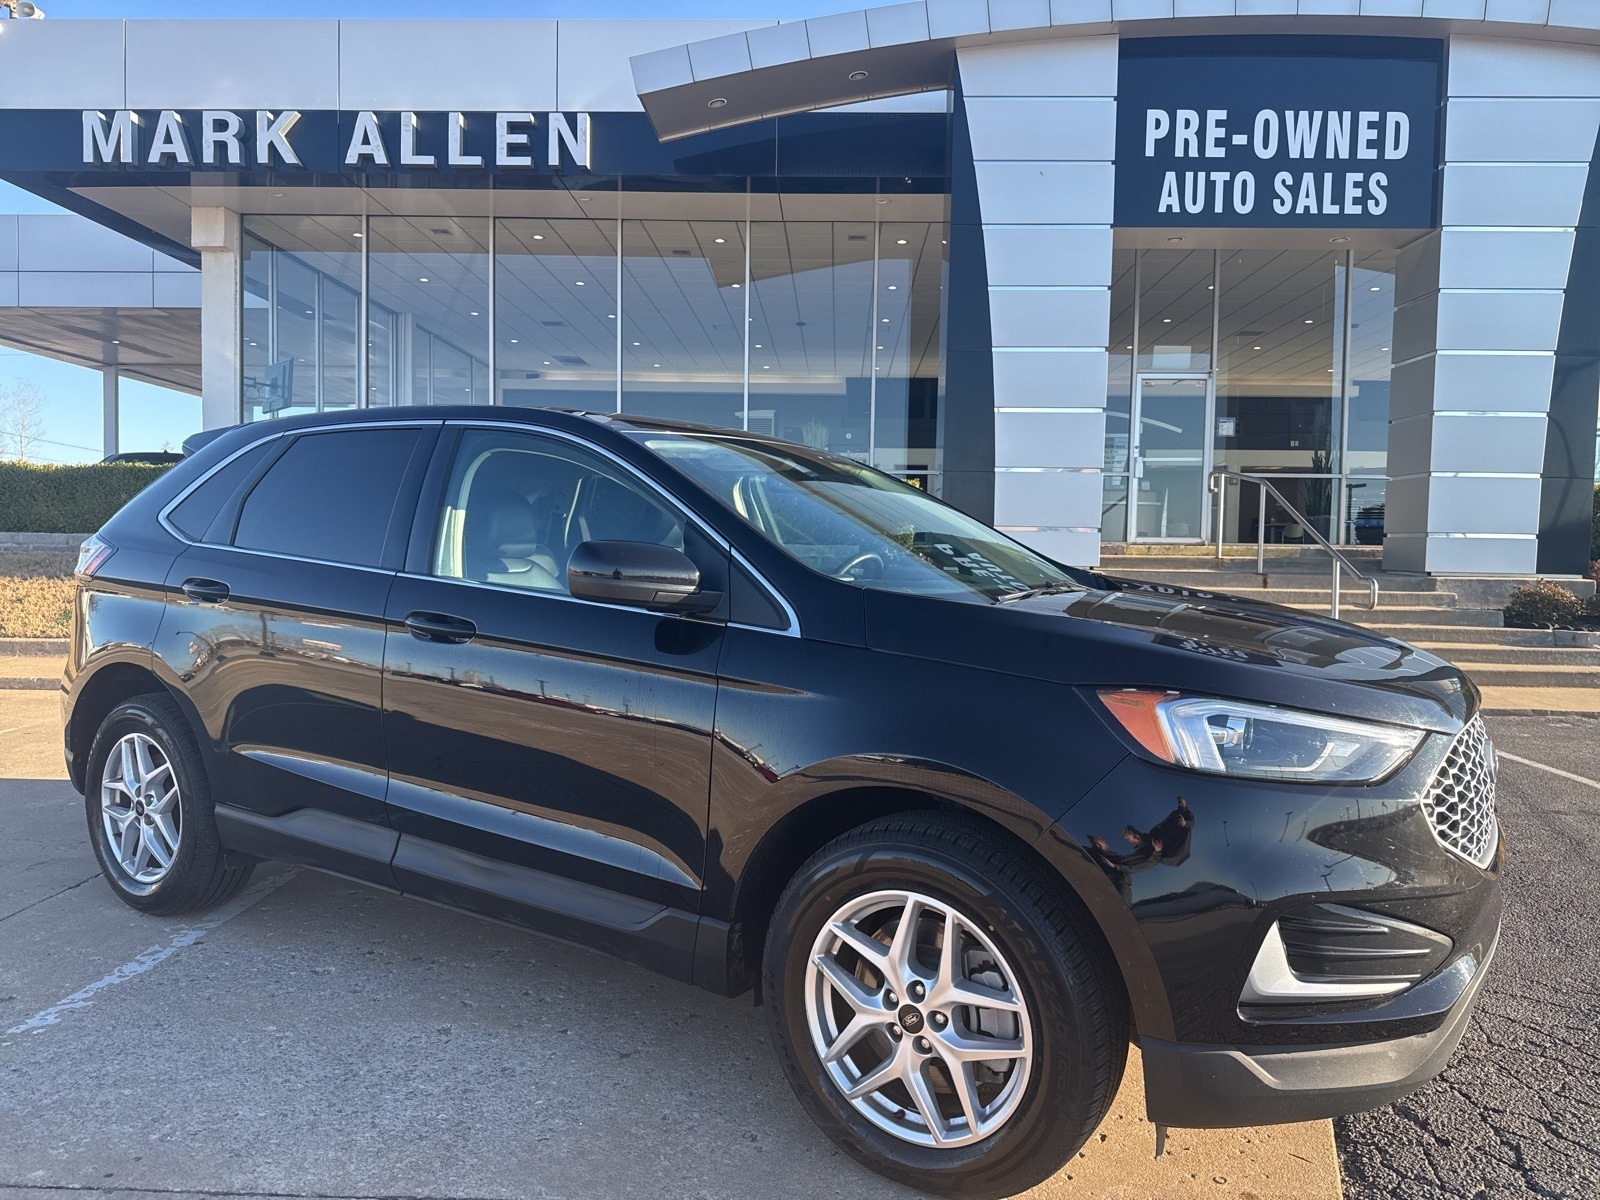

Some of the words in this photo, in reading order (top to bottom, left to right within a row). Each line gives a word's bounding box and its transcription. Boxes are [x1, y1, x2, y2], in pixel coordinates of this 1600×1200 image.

[82, 110, 302, 167] MARK
[344, 111, 592, 169] ALLEN
[1145, 108, 1410, 160] PRE-OWNED
[1157, 170, 1256, 214] AUTO
[1272, 171, 1388, 216] SALES
